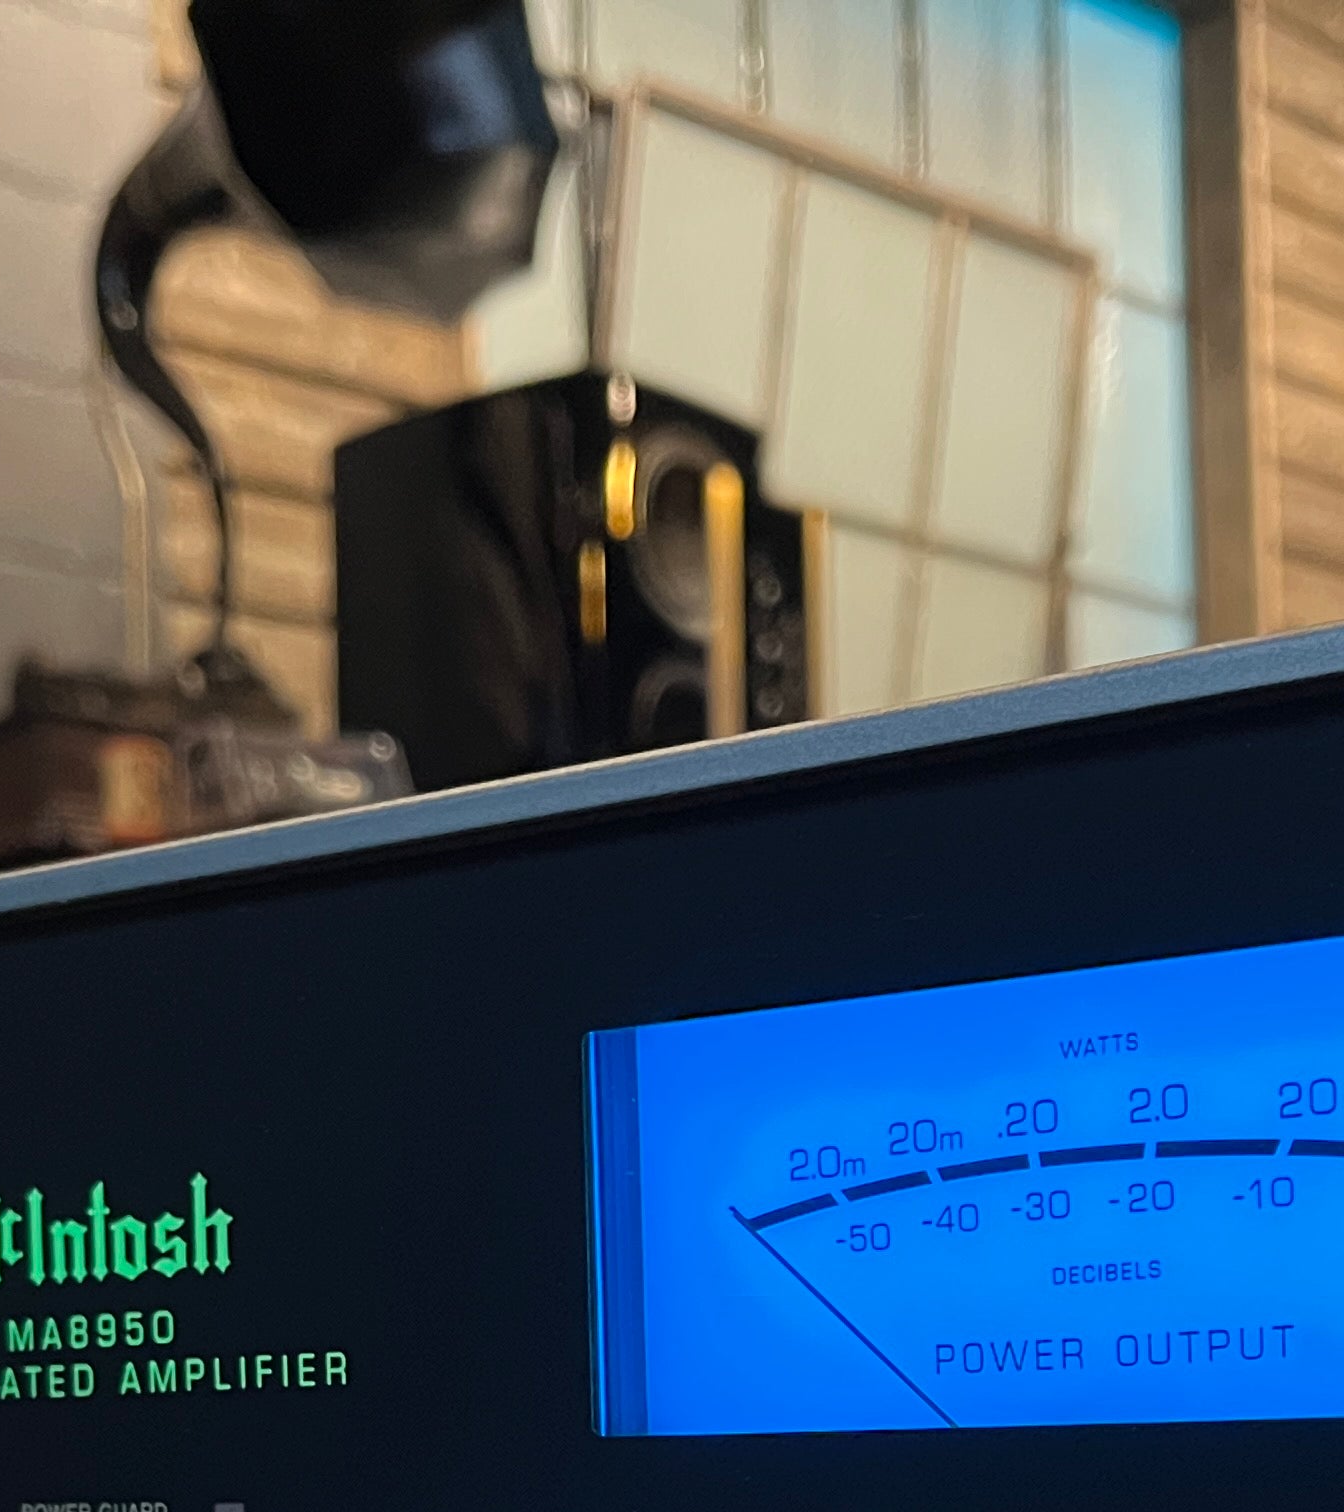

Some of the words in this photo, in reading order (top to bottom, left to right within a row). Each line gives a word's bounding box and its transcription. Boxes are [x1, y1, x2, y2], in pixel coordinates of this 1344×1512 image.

[1059, 1031, 1139, 1059] WATTS
[788, 1145, 866, 1182] 2.0m
[888, 1119, 964, 1156] 20m
[997, 1098, 1058, 1139] .20
[1129, 1083, 1189, 1124] 2.0
[1278, 1077, 1337, 1119] 20
[835, 1222, 891, 1252] -50
[921, 1203, 979, 1233] -40
[1009, 1189, 1071, 1221] -30
[1108, 1180, 1176, 1213] -20
[1232, 1176, 1295, 1210] -10
[1051, 1259, 1162, 1286] DECIBELS
[6, 1309, 176, 1353] MA8950
[935, 1337, 1084, 1375] POWER
[1116, 1324, 1295, 1367] OUTPUT
[120, 1351, 348, 1396] AMPLIFIER
